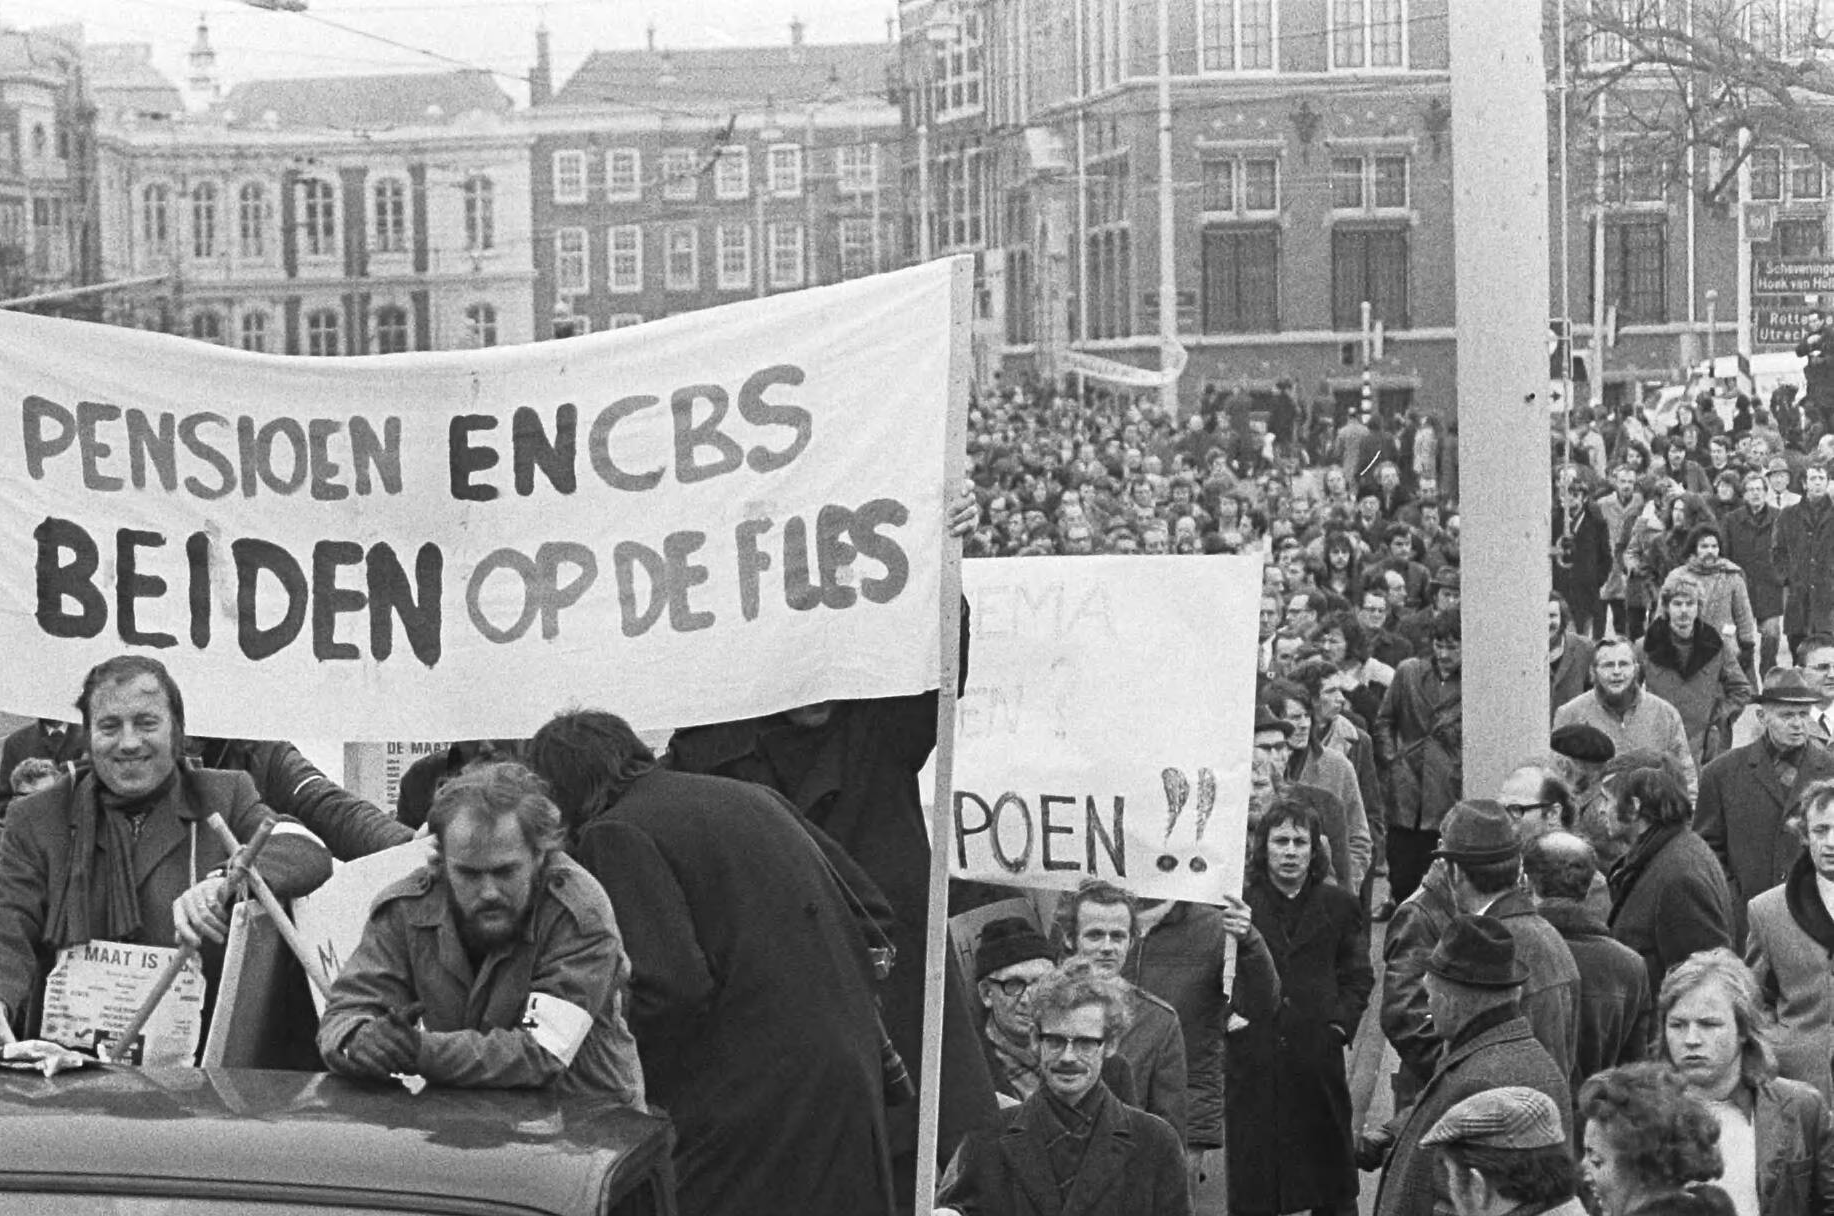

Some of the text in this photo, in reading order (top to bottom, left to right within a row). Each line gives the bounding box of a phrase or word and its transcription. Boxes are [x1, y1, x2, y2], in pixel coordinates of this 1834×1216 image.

[22, 395, 402, 501] PENSIOEN
[32, 498, 910, 669] BEIDEN OP DE FLES
[84, 945, 132, 966] MAAT
[141, 951, 159, 969] IS
